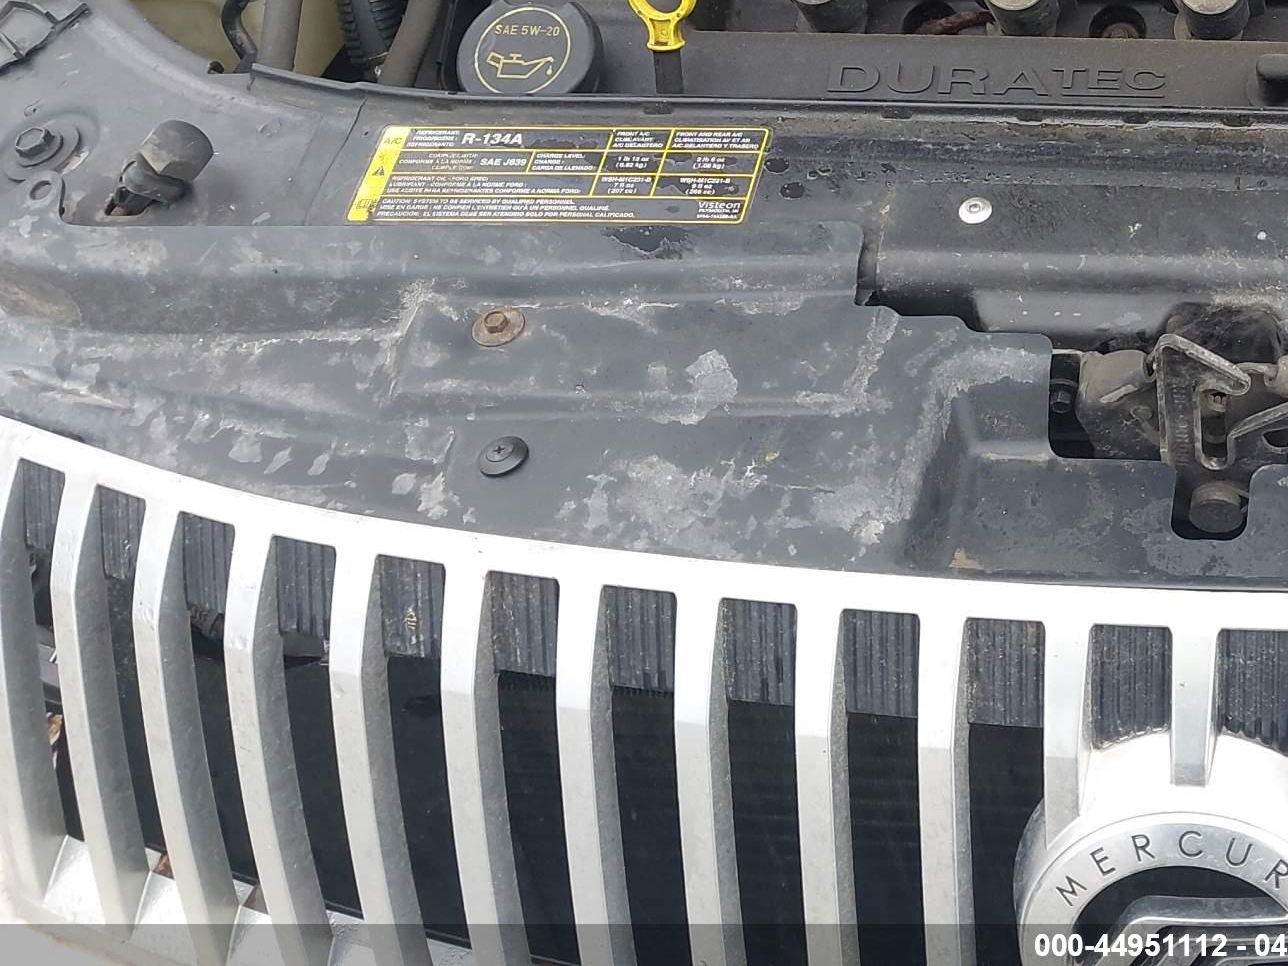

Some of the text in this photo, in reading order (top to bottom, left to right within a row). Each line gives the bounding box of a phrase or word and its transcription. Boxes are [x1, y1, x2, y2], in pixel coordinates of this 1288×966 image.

[494, 24, 561, 37] SAE 5W-20
[826, 63, 1167, 96] DURATEC
[461, 132, 523, 145] R-134A
[480, 157, 502, 167] SAE
[698, 201, 741, 209] Visteon
